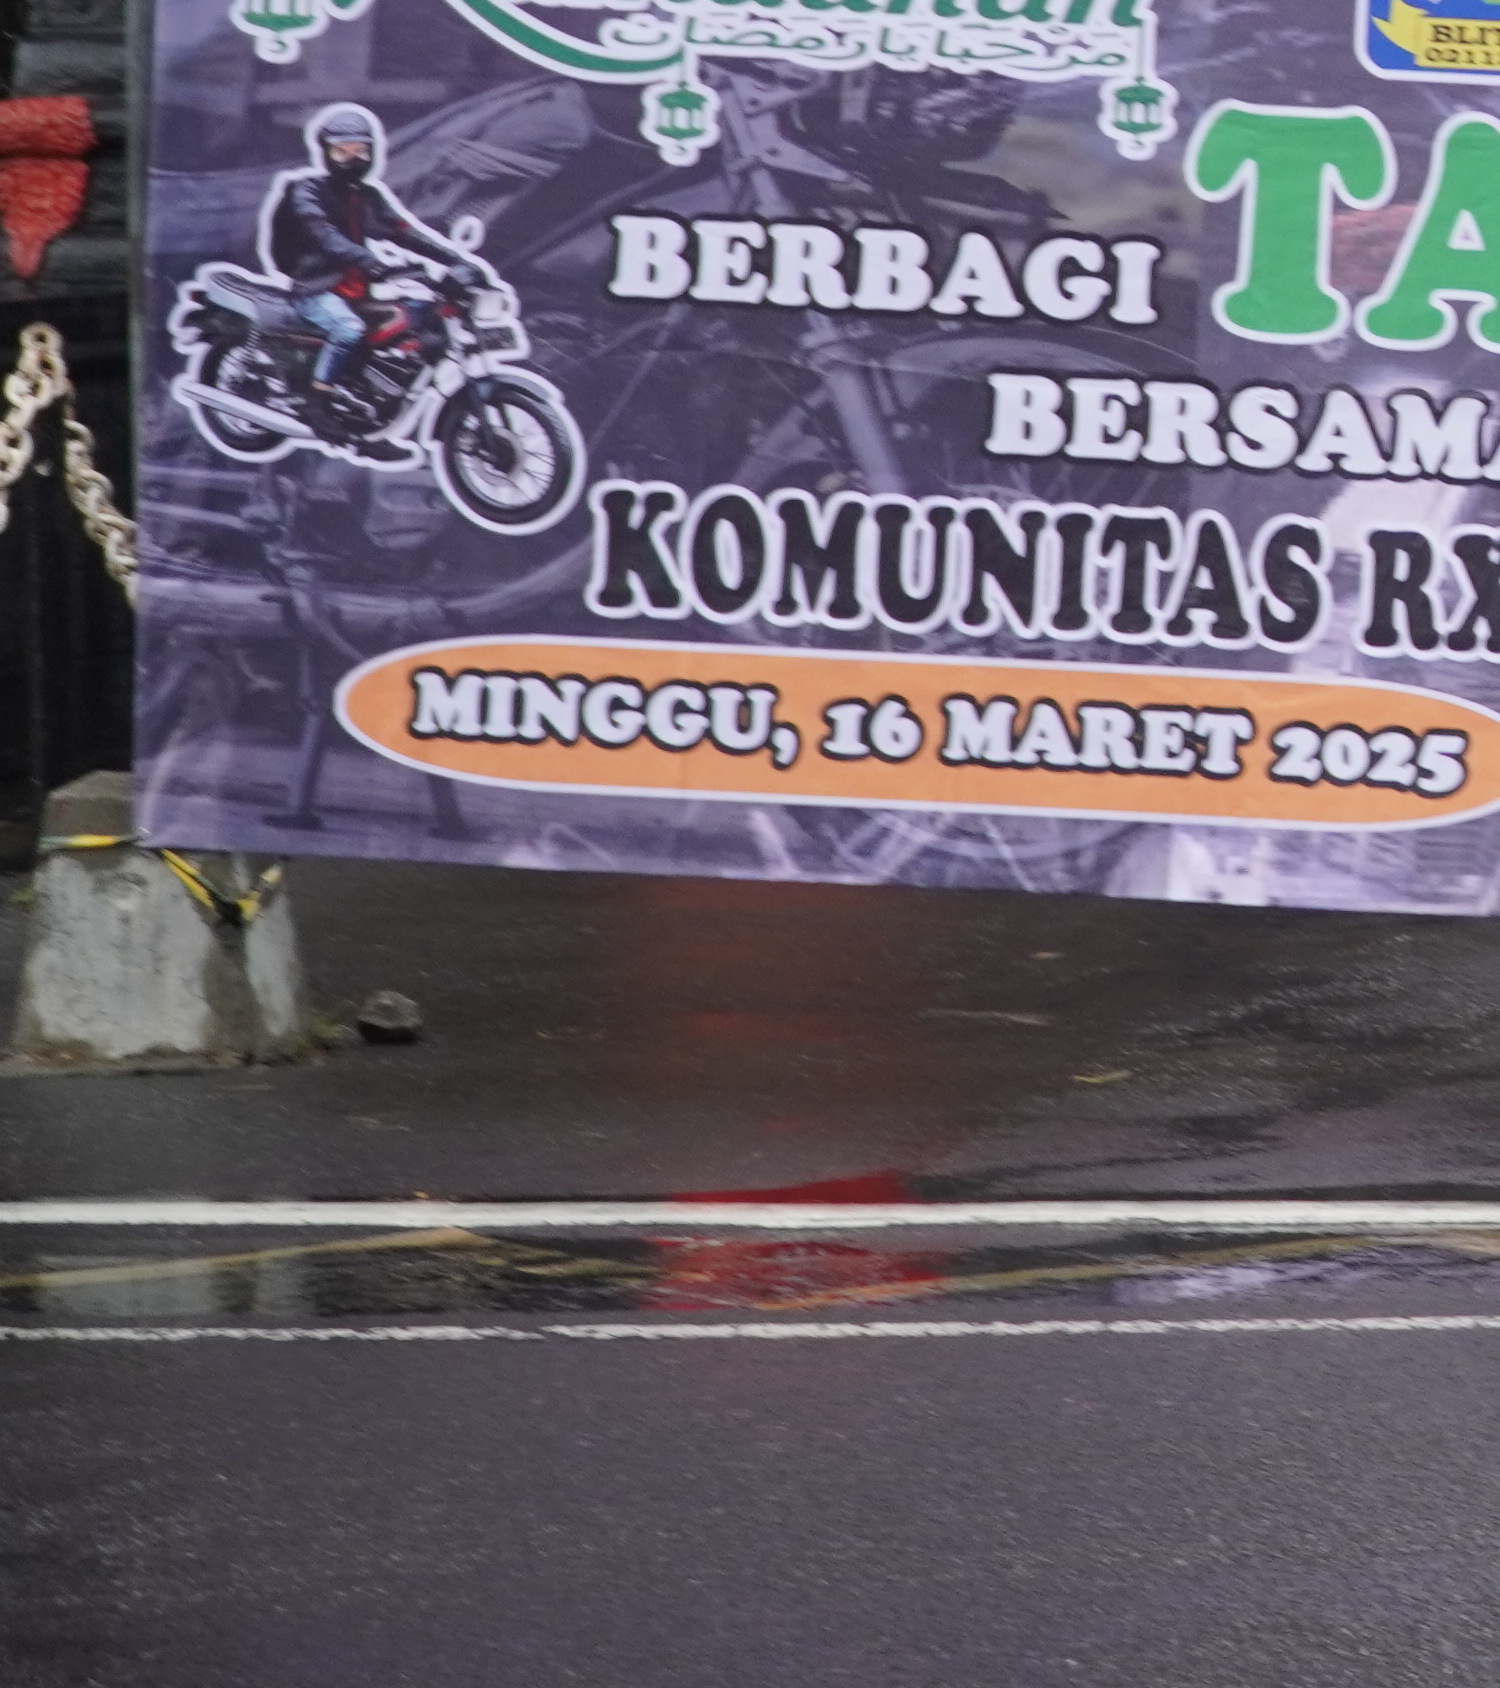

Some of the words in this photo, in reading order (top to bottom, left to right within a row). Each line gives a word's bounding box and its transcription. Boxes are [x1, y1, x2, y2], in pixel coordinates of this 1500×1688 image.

[609, 214, 1163, 324] BERBAGI
[590, 485, 1333, 647] KOMUNITAS
[411, 669, 799, 768] MINGGU,
[820, 698, 918, 762] 16
[942, 698, 1254, 779] MARET
[1271, 723, 1469, 798] 2025
